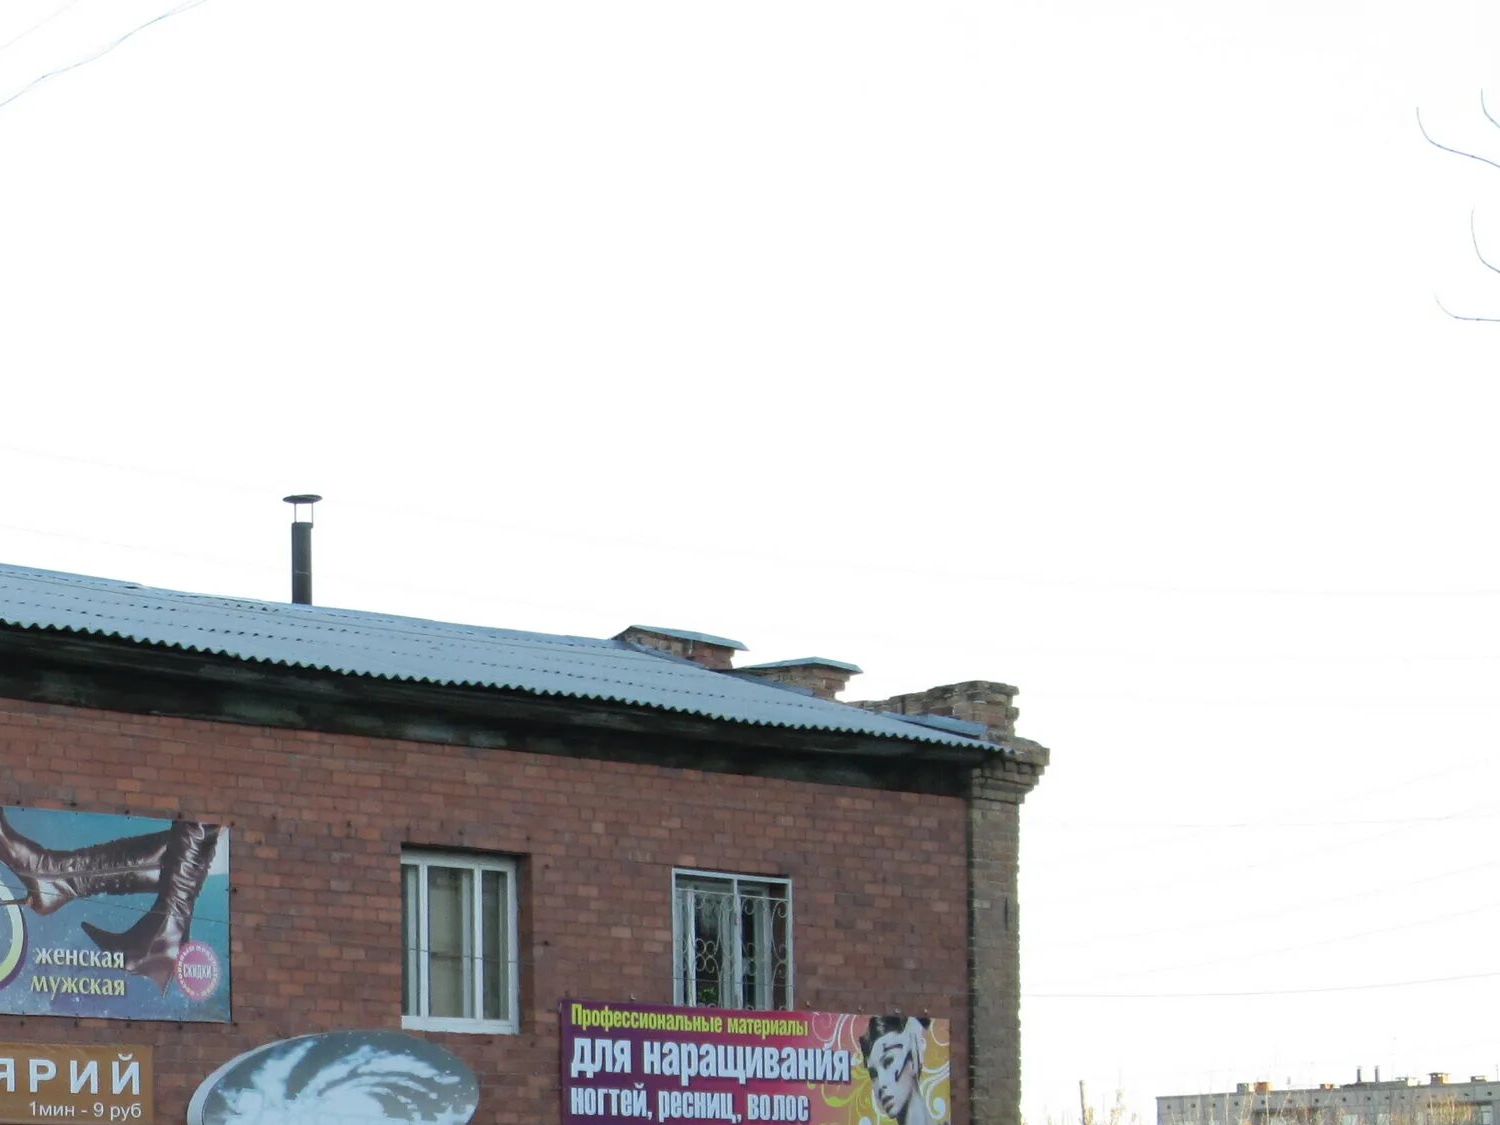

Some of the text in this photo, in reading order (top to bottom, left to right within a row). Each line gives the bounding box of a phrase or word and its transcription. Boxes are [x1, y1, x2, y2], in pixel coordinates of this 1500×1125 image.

[34, 947, 126, 969] женская
[30, 975, 126, 1001] мужская
[571, 1003, 809, 1040] Профессиональные материалы
[571, 1037, 850, 1086] для наращивания
[93, 1102, 104, 1118] 9
[110, 1102, 142, 1121] руб
[570, 1082, 810, 1124] ногтей, ресниц, волос
